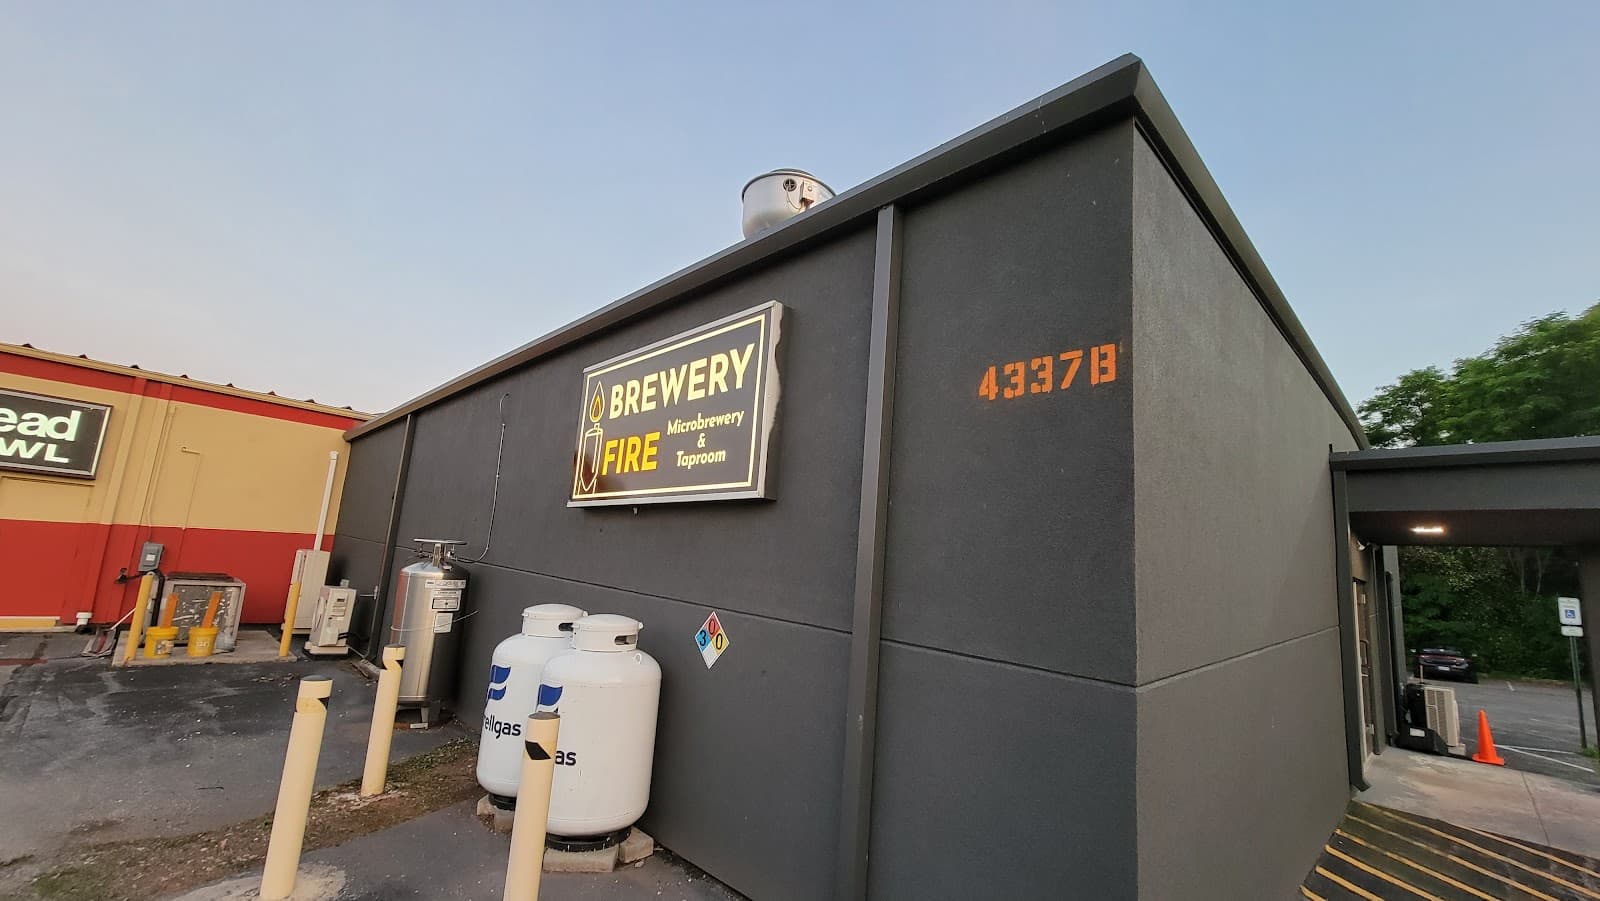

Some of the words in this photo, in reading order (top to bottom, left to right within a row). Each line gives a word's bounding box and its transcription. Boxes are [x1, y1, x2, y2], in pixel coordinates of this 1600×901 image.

[609, 343, 755, 420] BREWERY
[978, 343, 1117, 401] 4337B
[667, 410, 745, 436] Microbrewery
[697, 433, 706, 448] &
[601, 431, 660, 476] FIRE
[676, 450, 726, 469] Taproom
[700, 630, 706, 646] 3
[708, 619, 715, 635] 0
[716, 633, 722, 650] 0
[483, 714, 521, 739] ellgas
